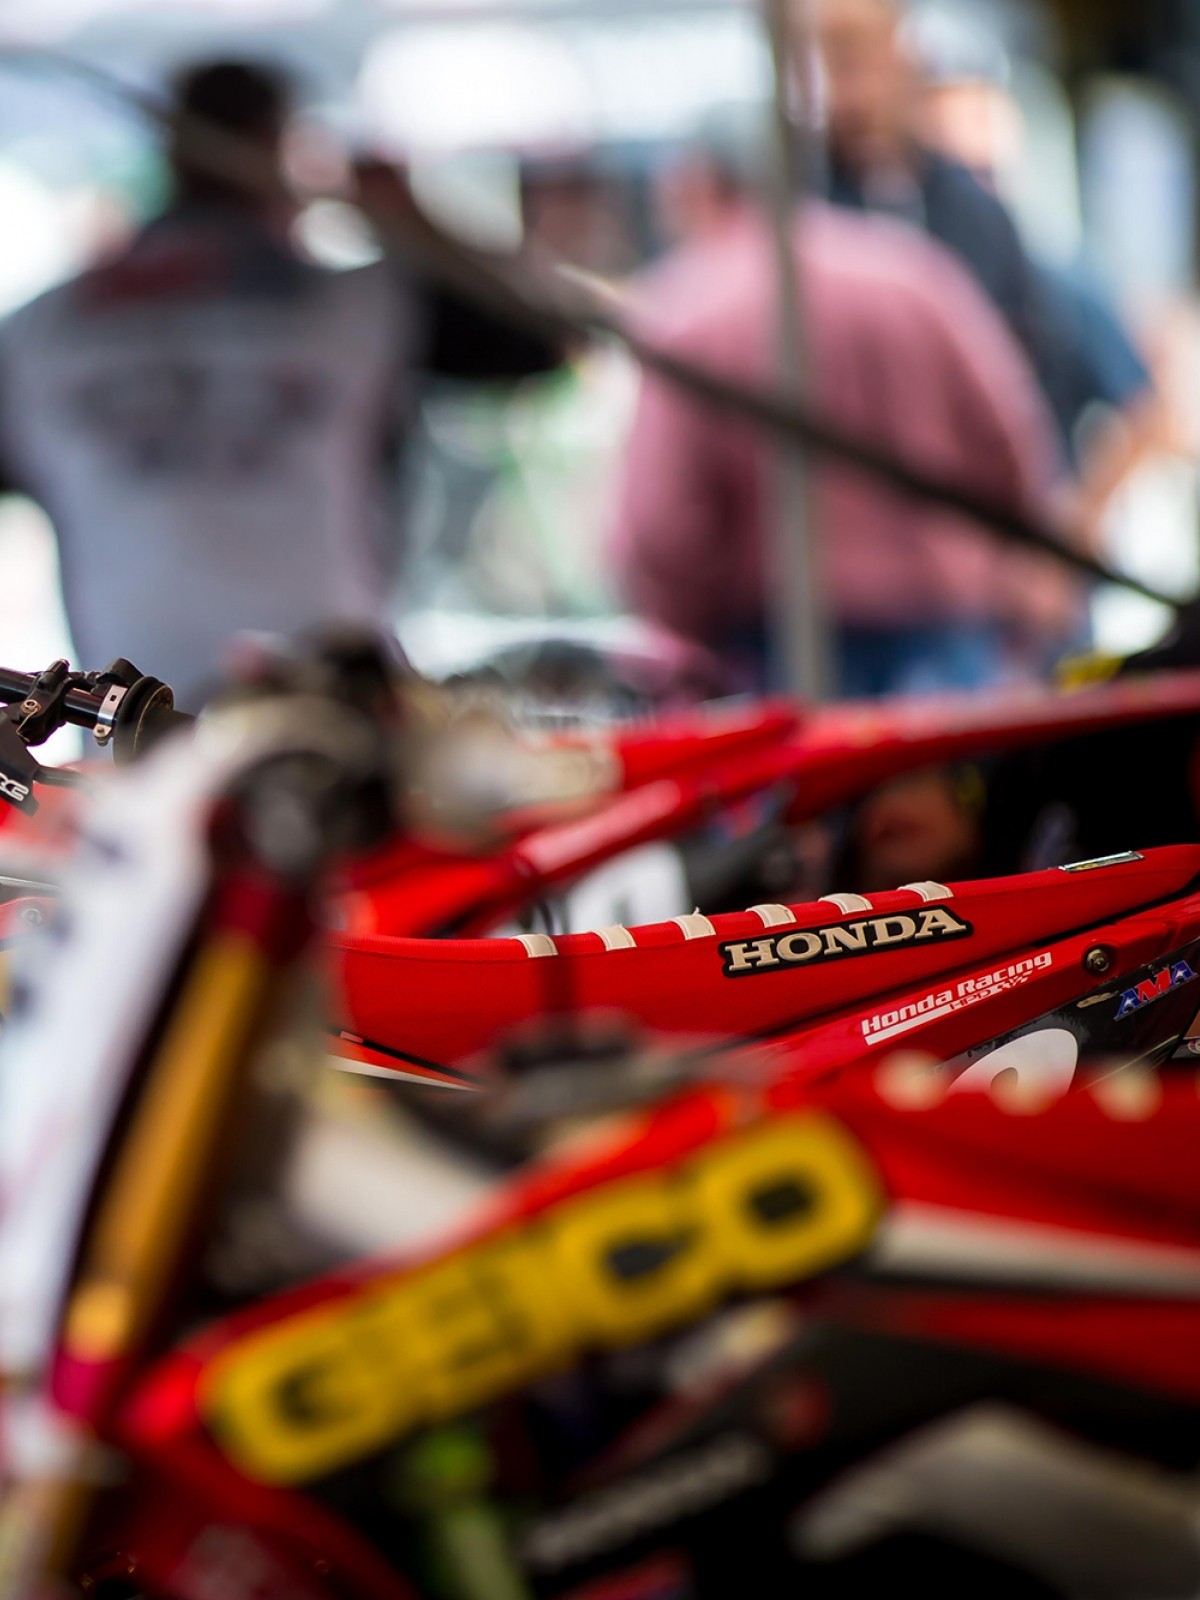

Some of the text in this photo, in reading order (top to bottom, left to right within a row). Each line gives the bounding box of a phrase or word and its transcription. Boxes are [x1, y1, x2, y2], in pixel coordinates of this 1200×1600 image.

[725, 908, 967, 972] HONDA
[861, 951, 1052, 1036] Honda Racing
[1113, 959, 1199, 1022] AMA
